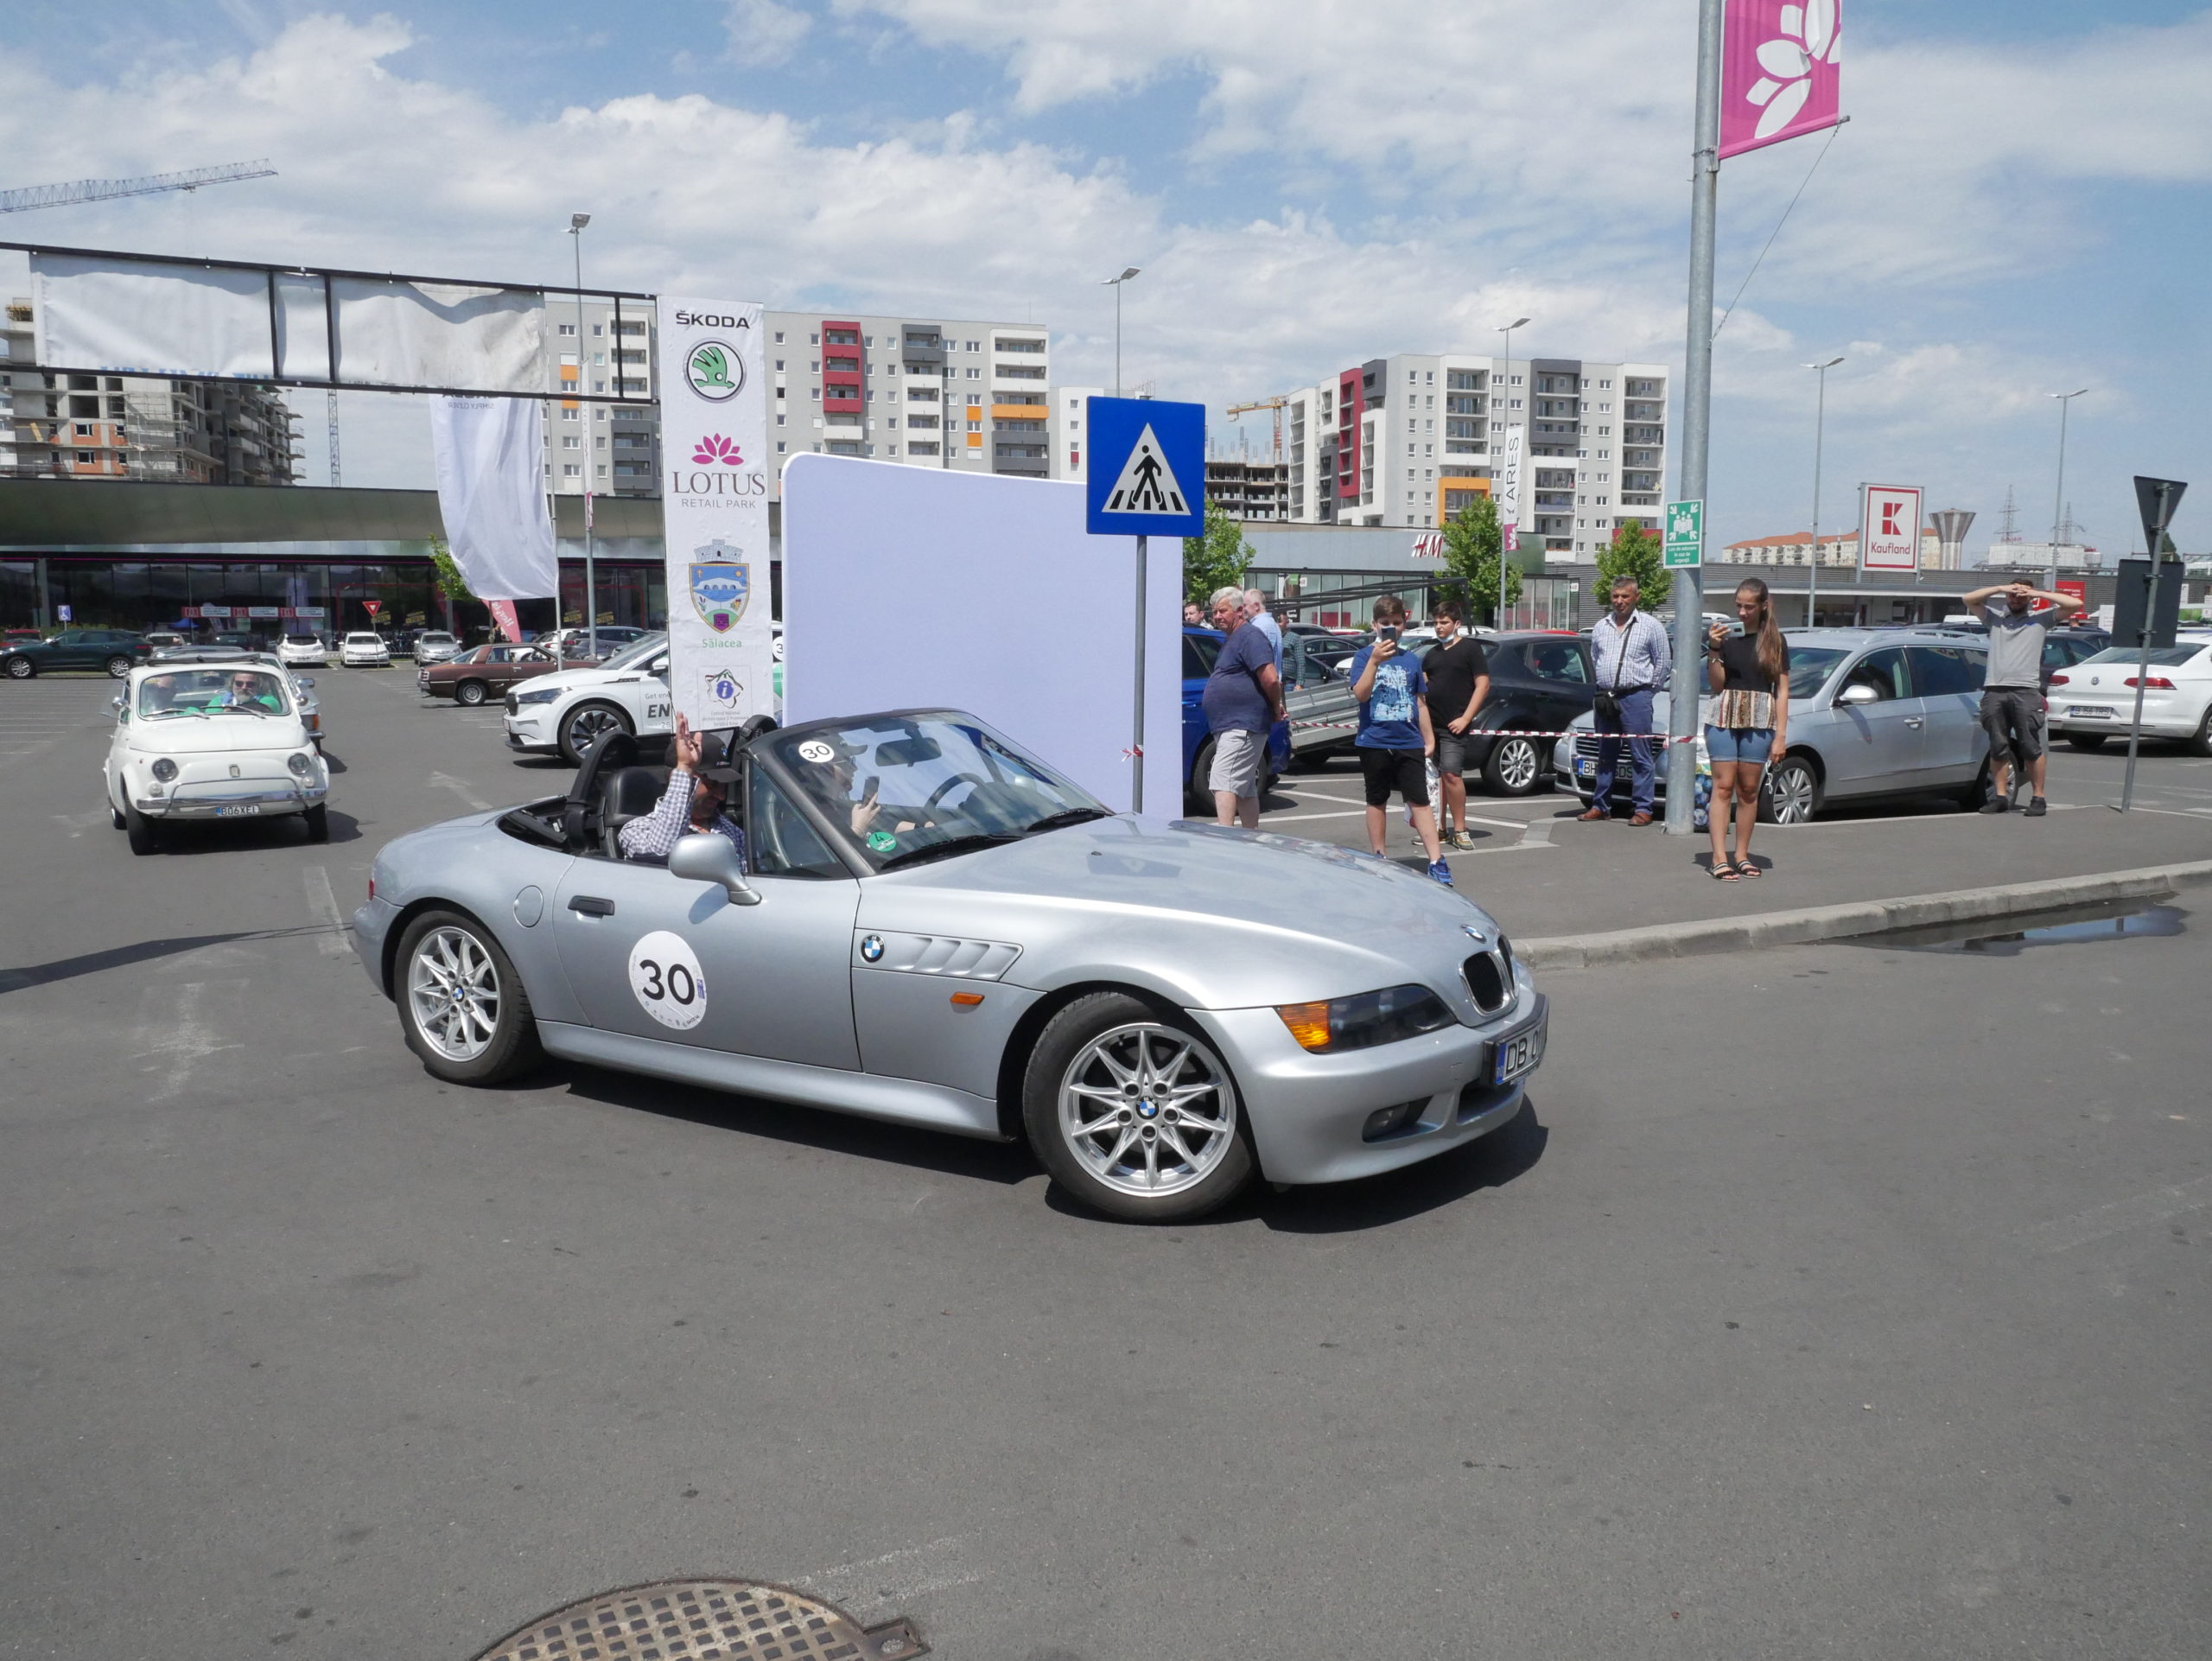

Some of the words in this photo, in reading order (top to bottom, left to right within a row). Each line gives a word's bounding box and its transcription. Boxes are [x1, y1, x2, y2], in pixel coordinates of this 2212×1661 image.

[676, 309, 750, 329] ŠKODA
[1506, 436, 1519, 500] ARES
[671, 471, 766, 496] LOTUS
[681, 498, 722, 508] RETAIL
[726, 499, 756, 509] PARK
[1871, 541, 1911, 555] Kaufland
[802, 745, 830, 760] 30
[639, 958, 695, 1006] 30
